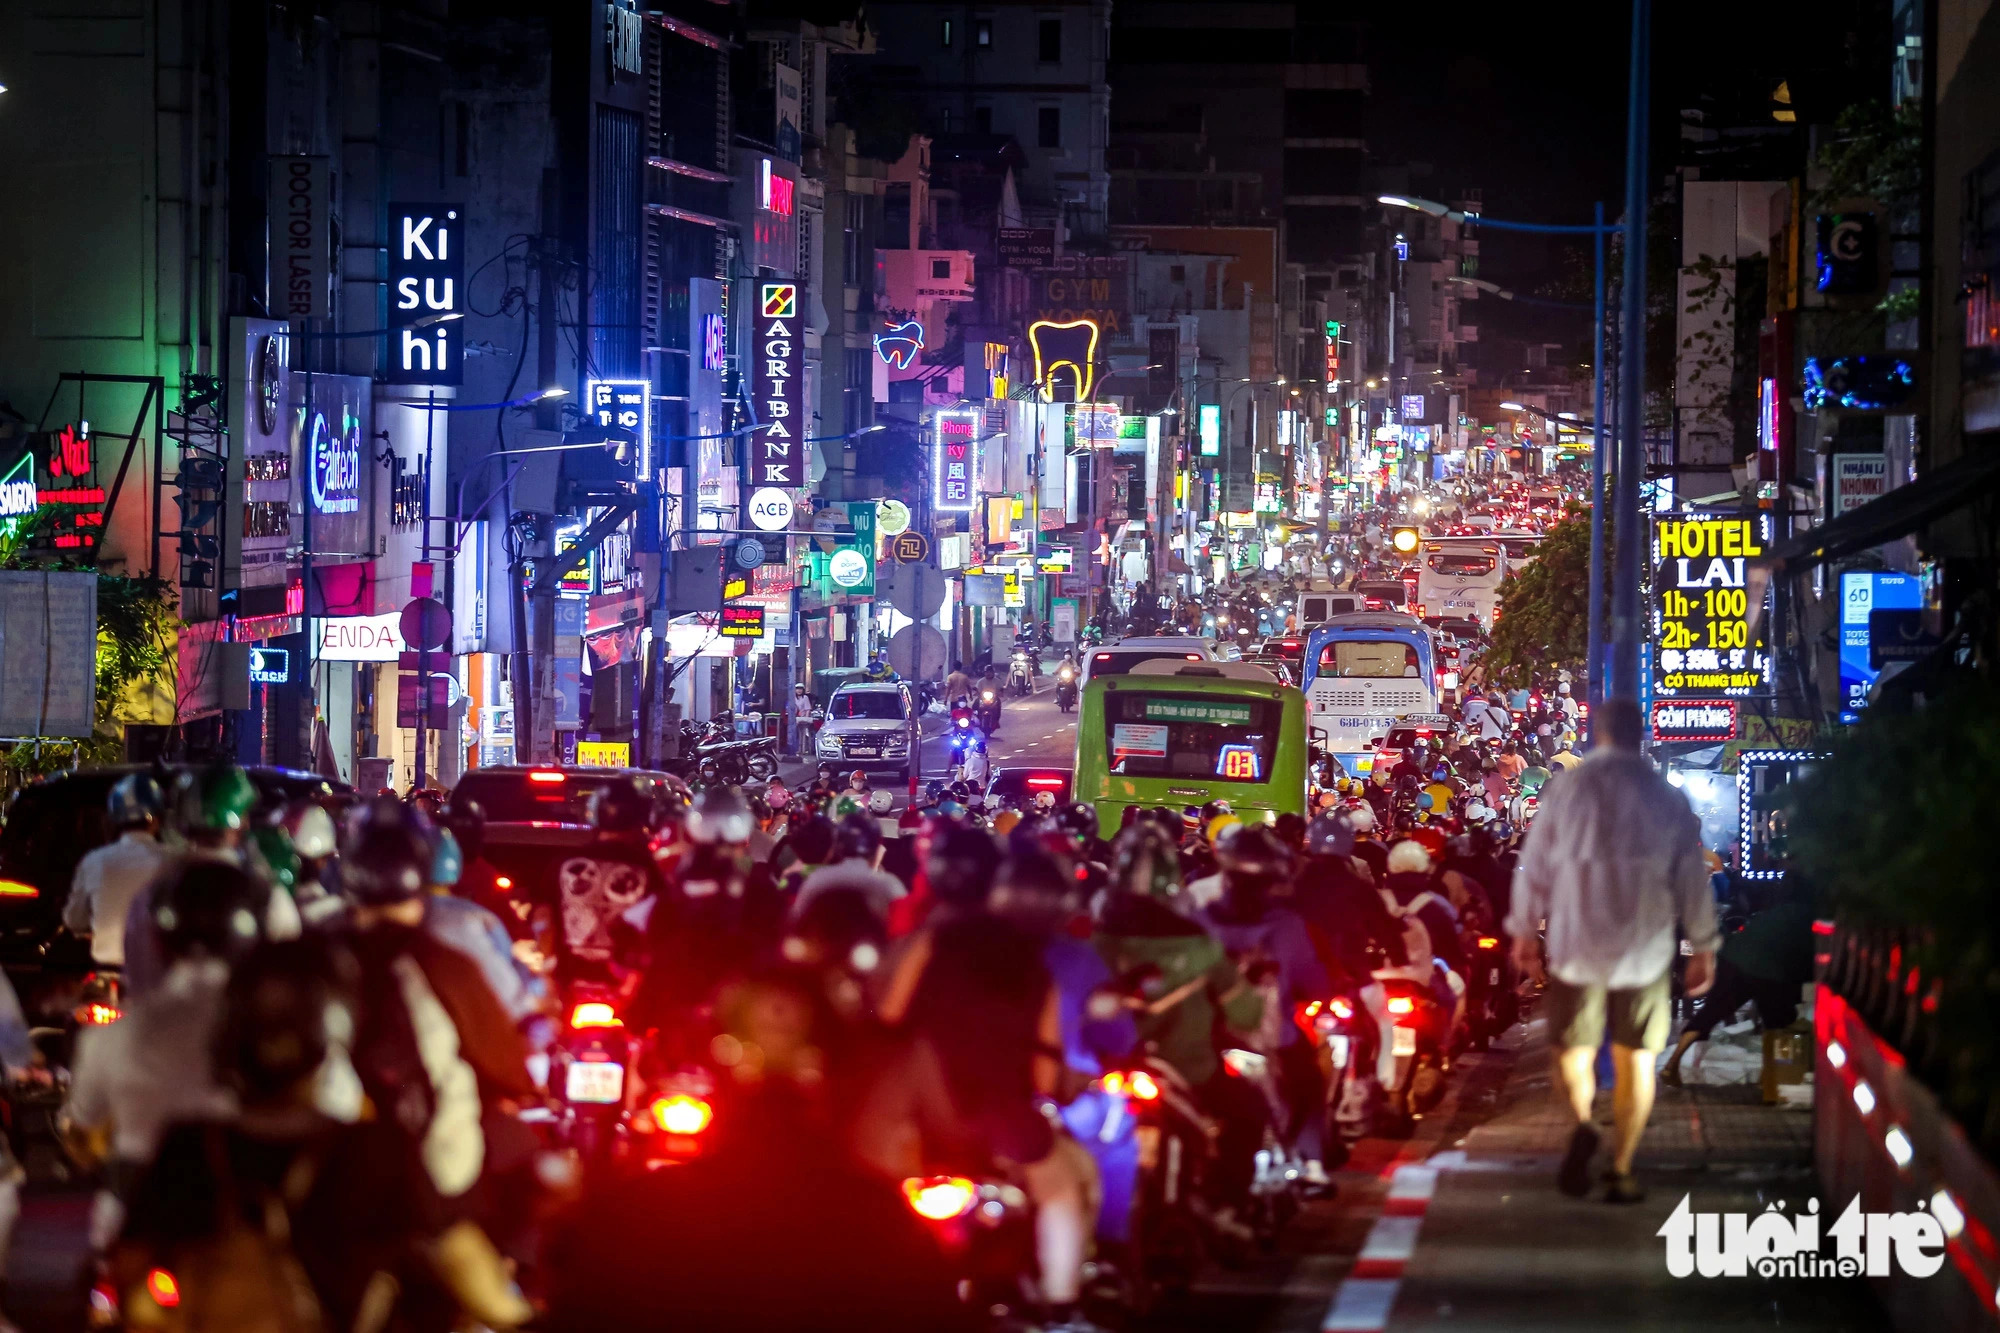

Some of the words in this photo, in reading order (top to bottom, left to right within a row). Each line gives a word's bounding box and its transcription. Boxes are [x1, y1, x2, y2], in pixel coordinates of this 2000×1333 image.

[288, 162, 311, 249] DOCTOR
[403, 217, 447, 260] Ki
[1000, 230, 1034, 239] BODY
[1000, 245, 1019, 253] GYM
[1027, 246, 1052, 254] YOGA
[1008, 257, 1042, 265] BOXING
[288, 255, 311, 315] LASER
[398, 277, 454, 310] su
[1047, 278, 1110, 301] GYM
[402, 327, 448, 371] hi
[765, 319, 792, 483] AGRIBANK
[941, 420, 974, 437] Phong
[946, 462, 967, 500] 風記
[0, 481, 37, 516] SAIGON
[755, 503, 788, 516] ACB
[854, 511, 870, 531] MŨ
[1660, 520, 1761, 558] HOTEL
[1676, 558, 1746, 588] LAI
[1879, 577, 1905, 585] TOTO
[1704, 588, 1747, 618] 100
[1849, 588, 1869, 602] 60
[323, 624, 398, 648] ENDA
[1706, 620, 1748, 648] 150
[1664, 671, 1685, 687] CÓ
[1685, 674, 1730, 688] THANG
[1730, 671, 1759, 687] MÁY
[1226, 751, 1253, 777] 03
